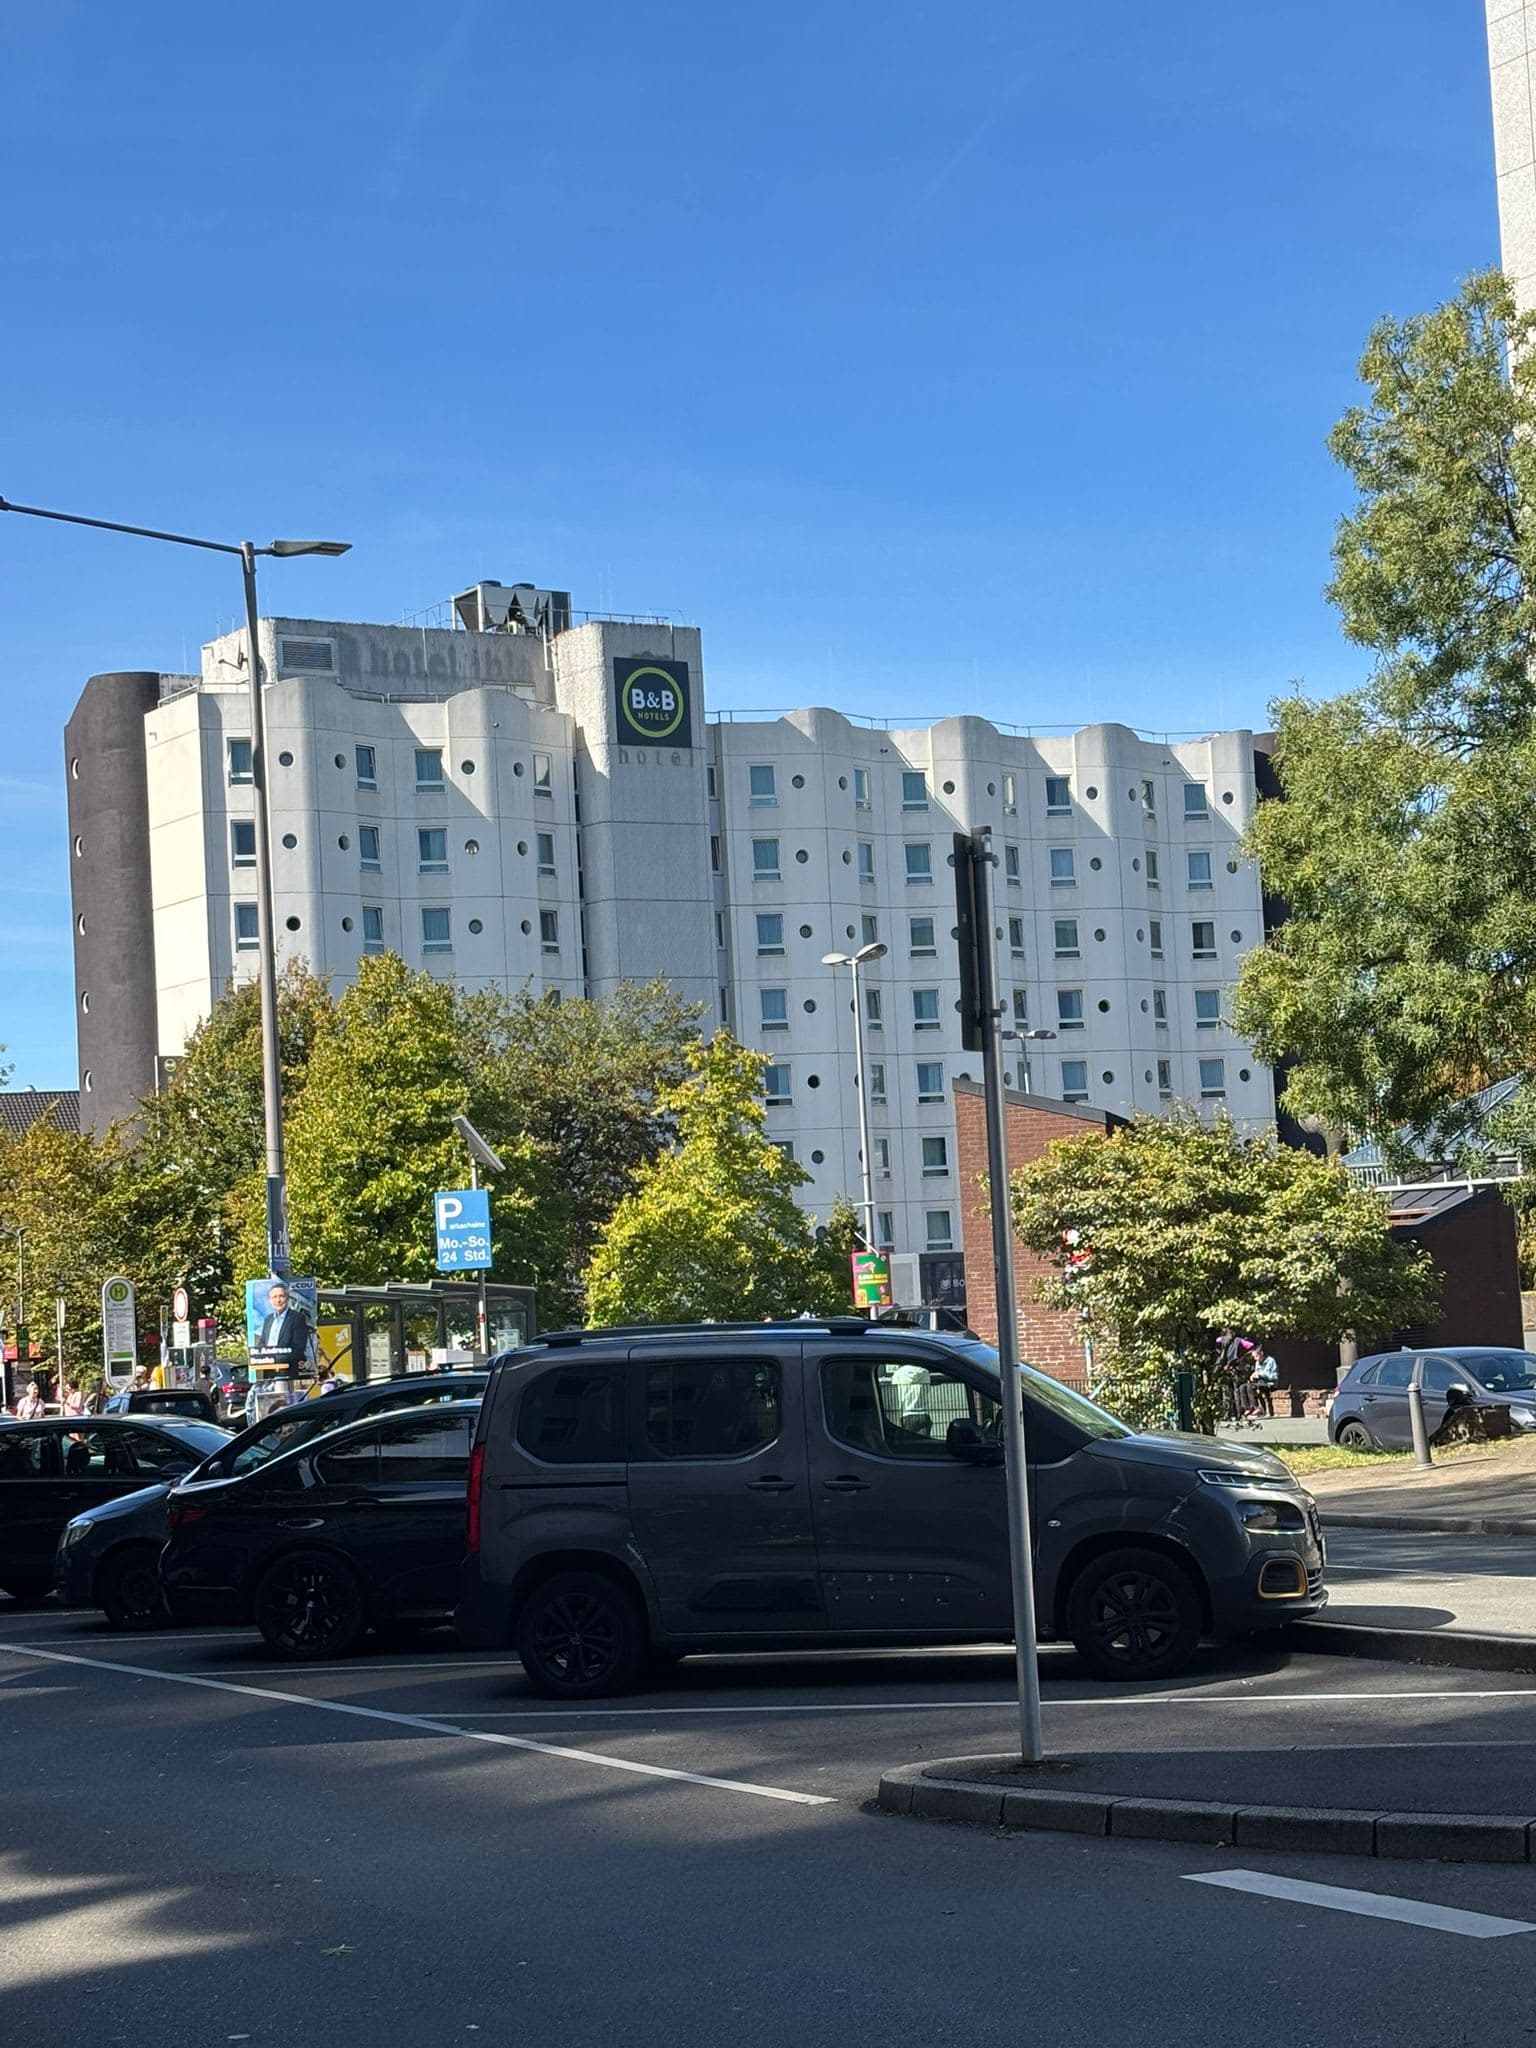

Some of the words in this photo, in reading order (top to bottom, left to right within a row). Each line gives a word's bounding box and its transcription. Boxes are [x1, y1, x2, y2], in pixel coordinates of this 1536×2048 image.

[631, 688, 675, 711] B&B
[637, 711, 670, 721] HOTELS
[440, 1235, 490, 1249] Mo.-So.
[442, 1251, 458, 1263] 24
[464, 1248, 490, 1261] Std.
